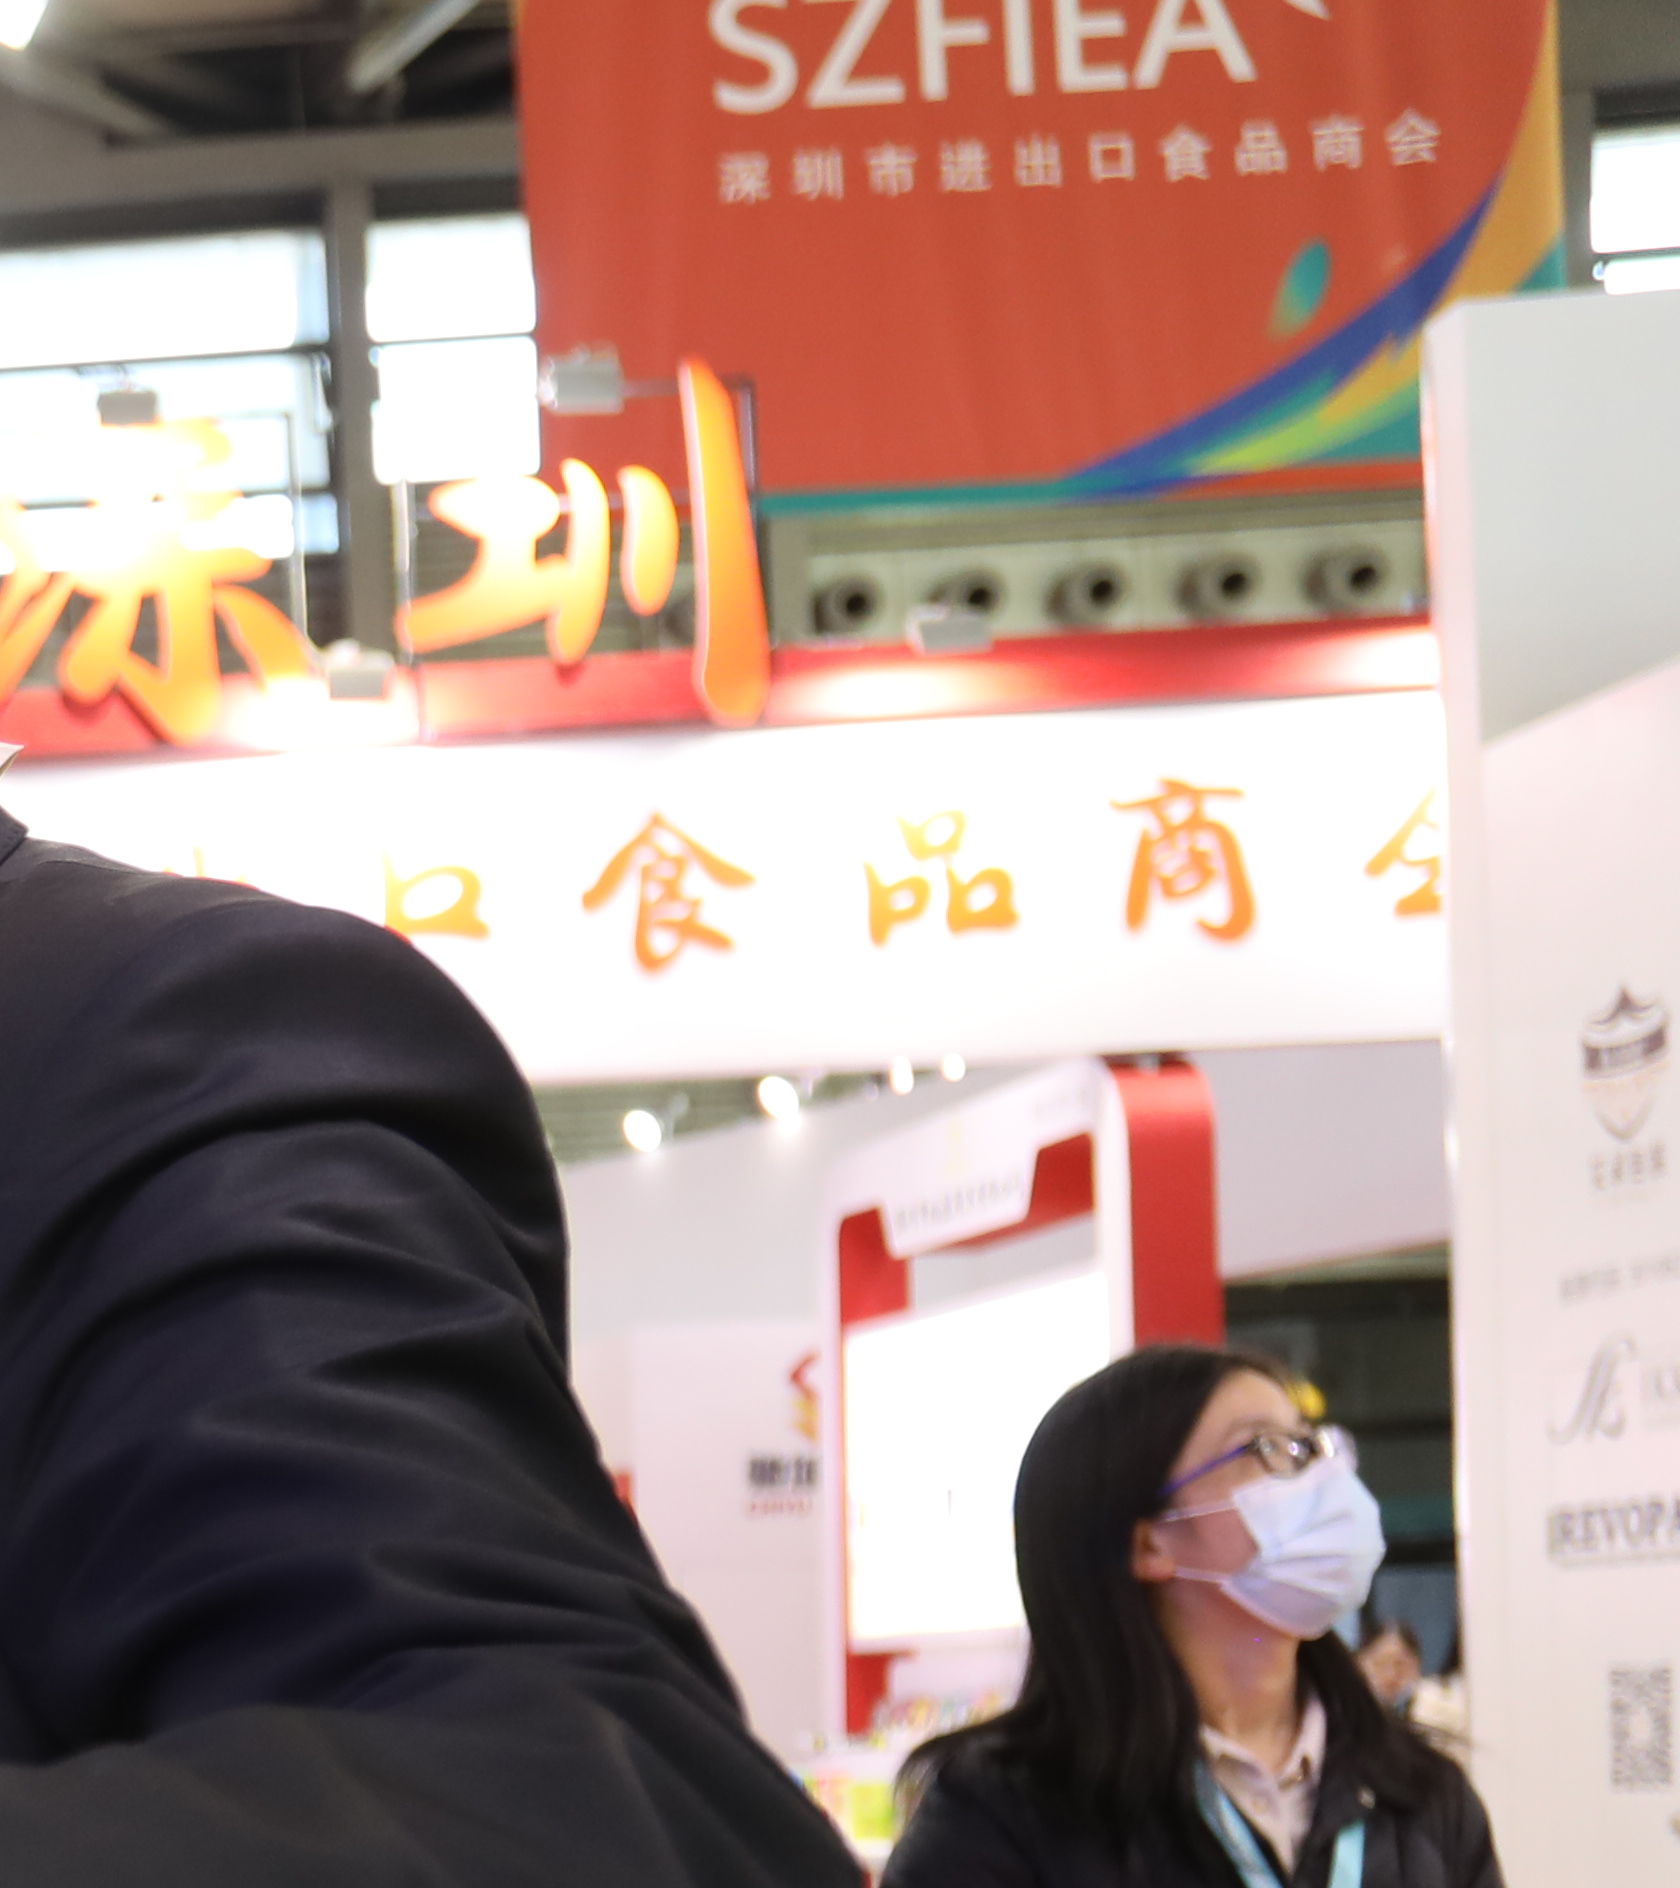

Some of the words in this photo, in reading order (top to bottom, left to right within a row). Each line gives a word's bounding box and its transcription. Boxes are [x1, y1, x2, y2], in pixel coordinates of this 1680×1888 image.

[708, 0, 1257, 114] SZFIEA
[717, 106, 1444, 203] 深圳市进出口食品商会
